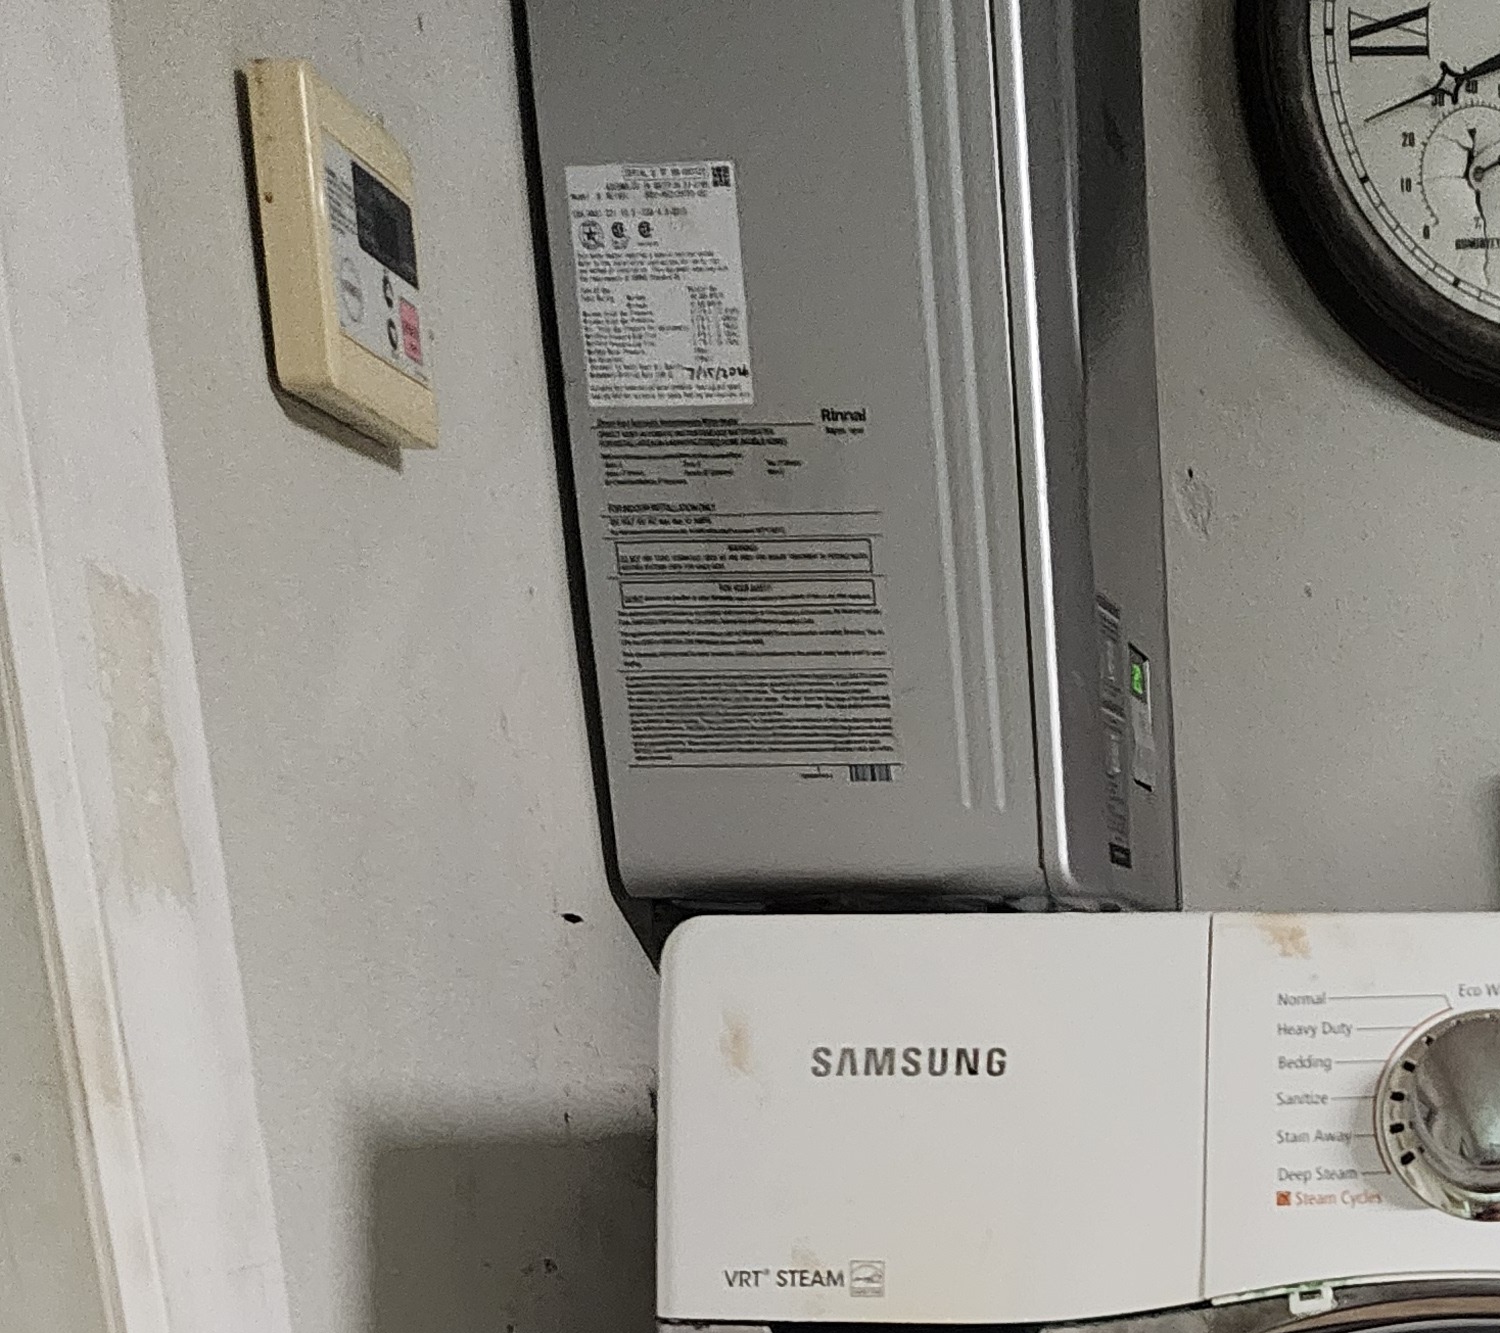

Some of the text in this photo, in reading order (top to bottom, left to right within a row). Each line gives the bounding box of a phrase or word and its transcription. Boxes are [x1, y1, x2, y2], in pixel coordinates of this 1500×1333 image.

[1401, 132, 1415, 147] 20
[1400, 178, 1412, 192] 10
[1458, 983, 1483, 997] Eco
[1277, 992, 1327, 1006] Normal
[1277, 1021, 1353, 1038] Heavy Duty
[810, 1046, 1009, 1078] SAMSUNG
[1278, 1054, 1333, 1073] Bedding
[1277, 1091, 1329, 1105] Sanitize
[1277, 1129, 1352, 1145] Stain Away
[1277, 1166, 1358, 1185] Deep Steam
[1295, 1190, 1383, 1208] Steam Cycles
[776, 1269, 845, 1288] STEAM
